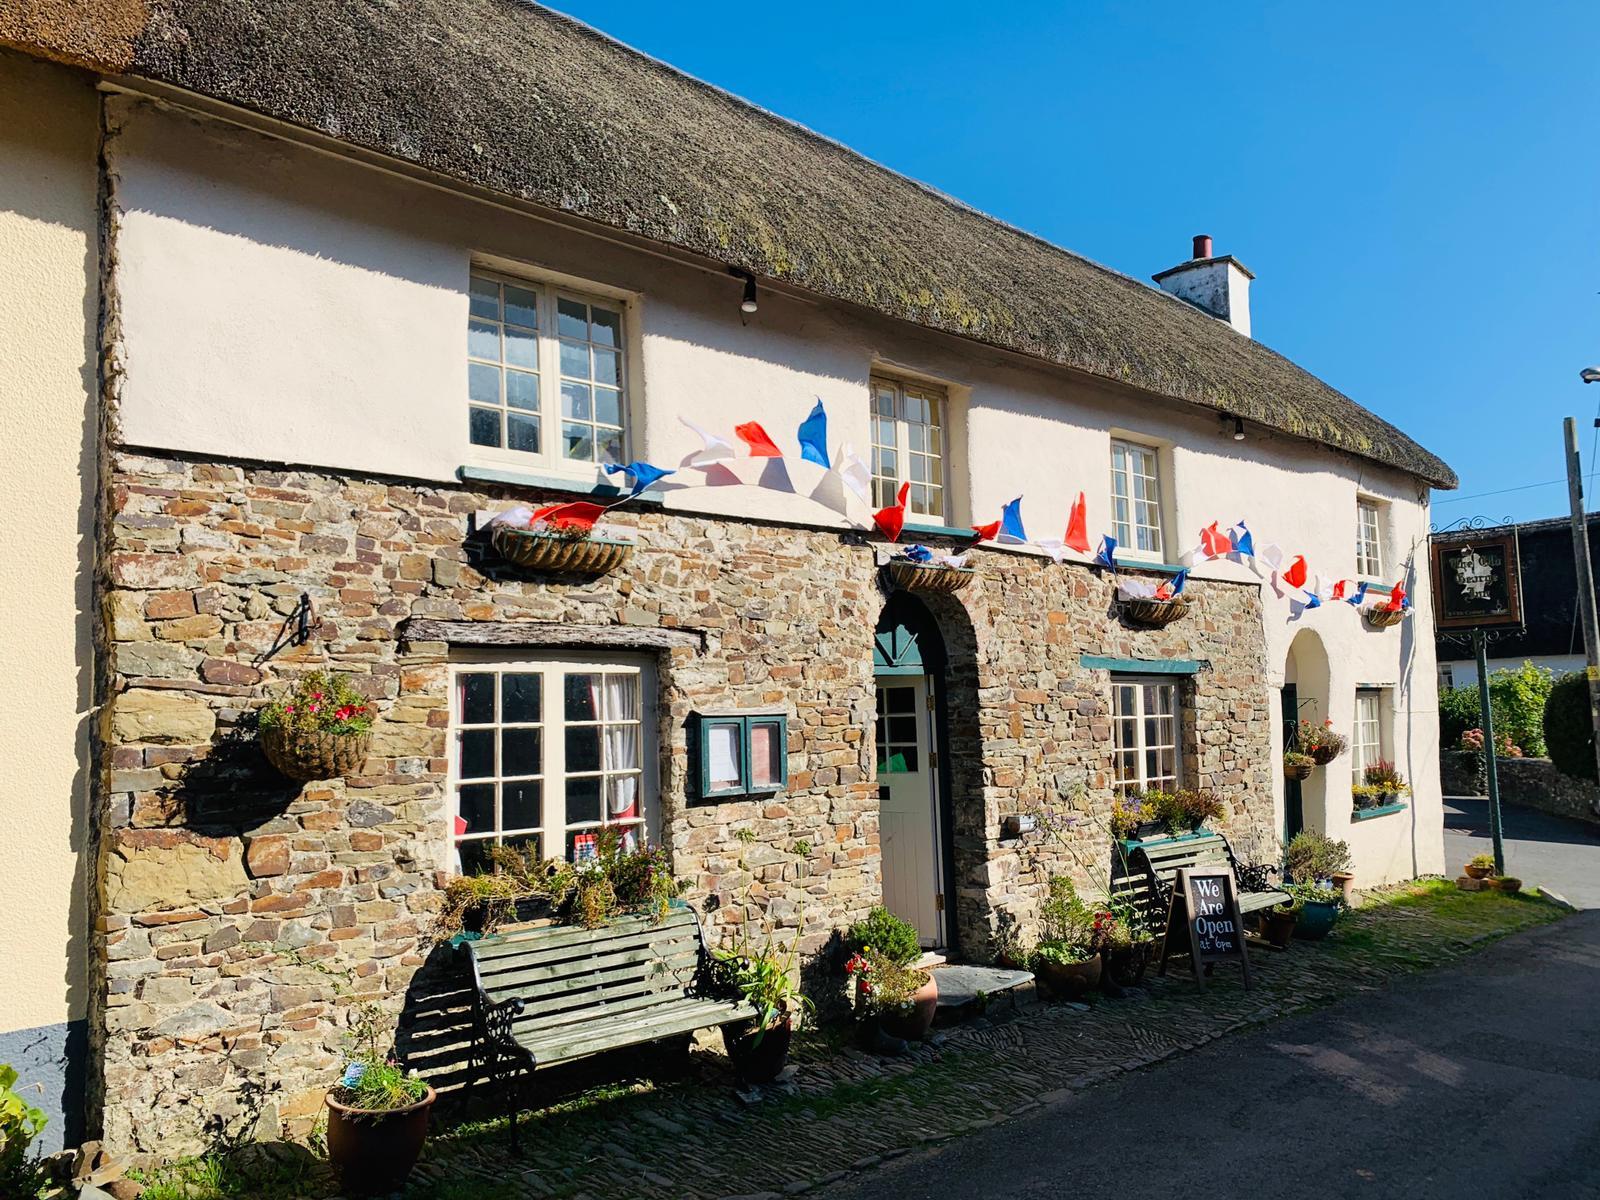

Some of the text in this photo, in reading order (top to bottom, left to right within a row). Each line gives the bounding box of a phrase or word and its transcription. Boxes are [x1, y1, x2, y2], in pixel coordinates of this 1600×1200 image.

[1195, 879, 1220, 897] We
[1198, 899, 1224, 916] Are
[1195, 916, 1235, 939] Open
[1199, 936, 1233, 952] at 6pm
